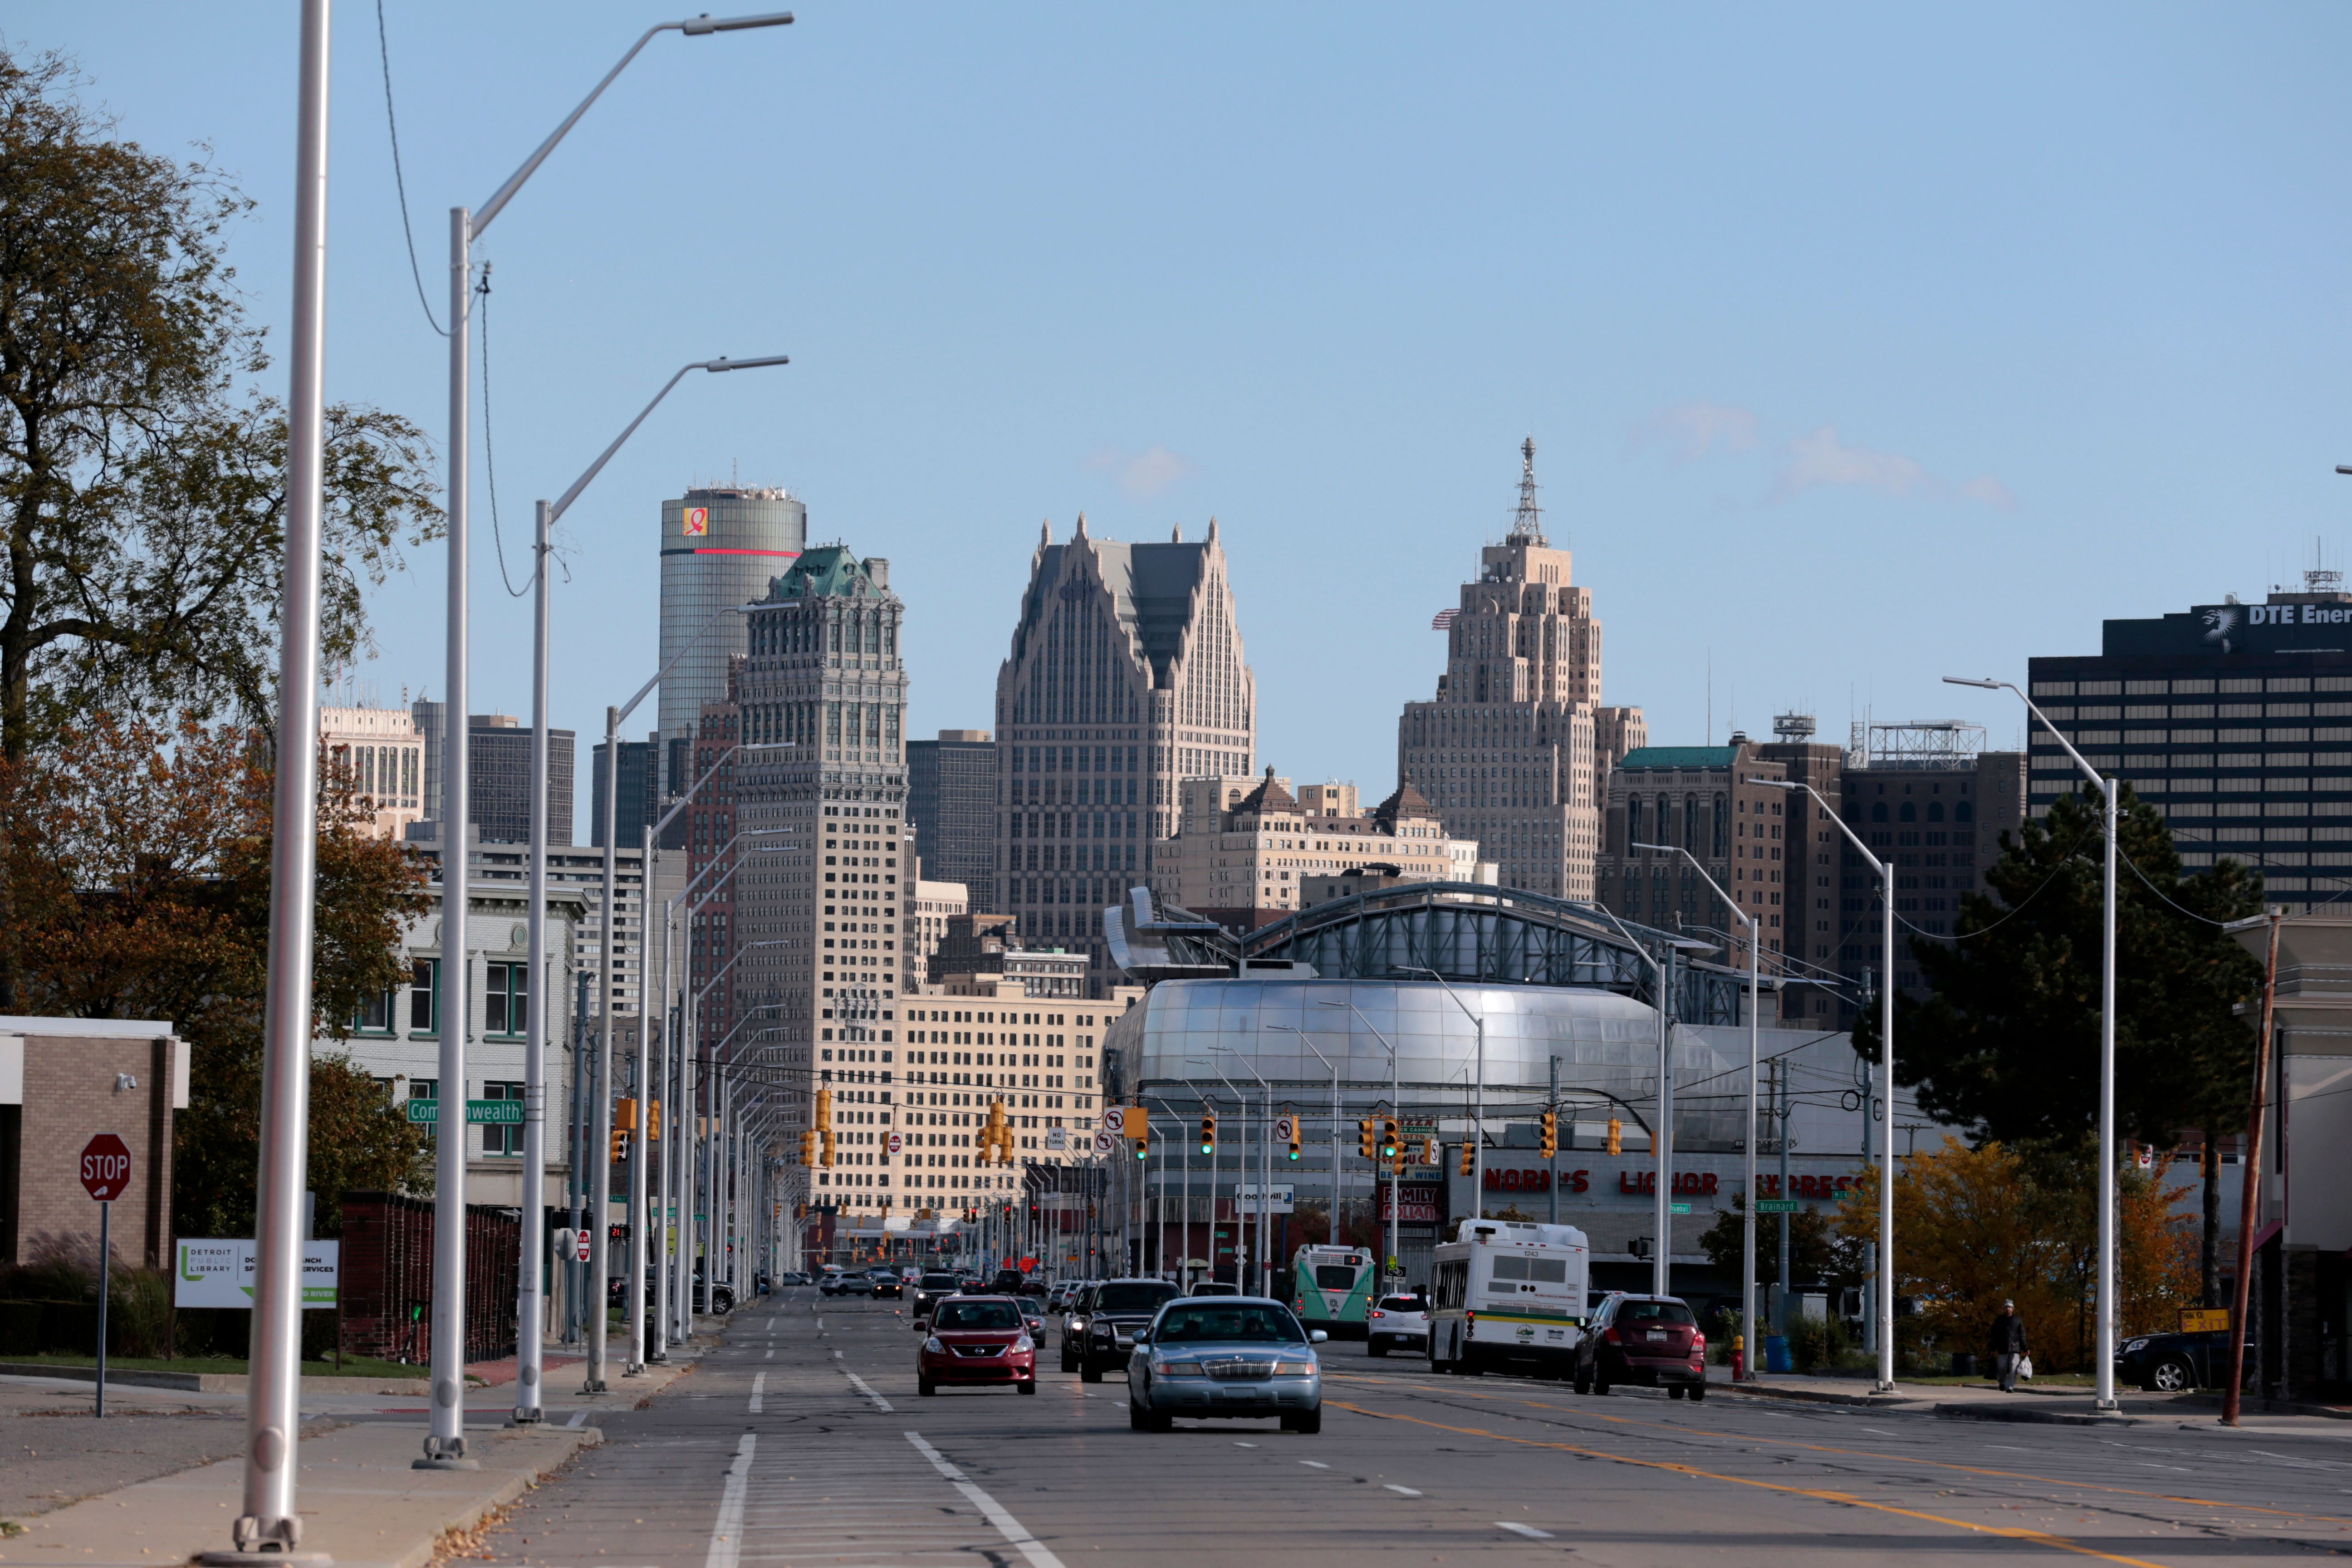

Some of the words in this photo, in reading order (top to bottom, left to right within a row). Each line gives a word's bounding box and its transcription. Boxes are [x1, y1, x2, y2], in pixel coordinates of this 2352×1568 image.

[2249, 606, 2294, 625] DTE
[411, 1103, 519, 1120] Comnwealth
[83, 1155, 128, 1180] STOP
[1760, 1202, 1793, 1211] Brainard
